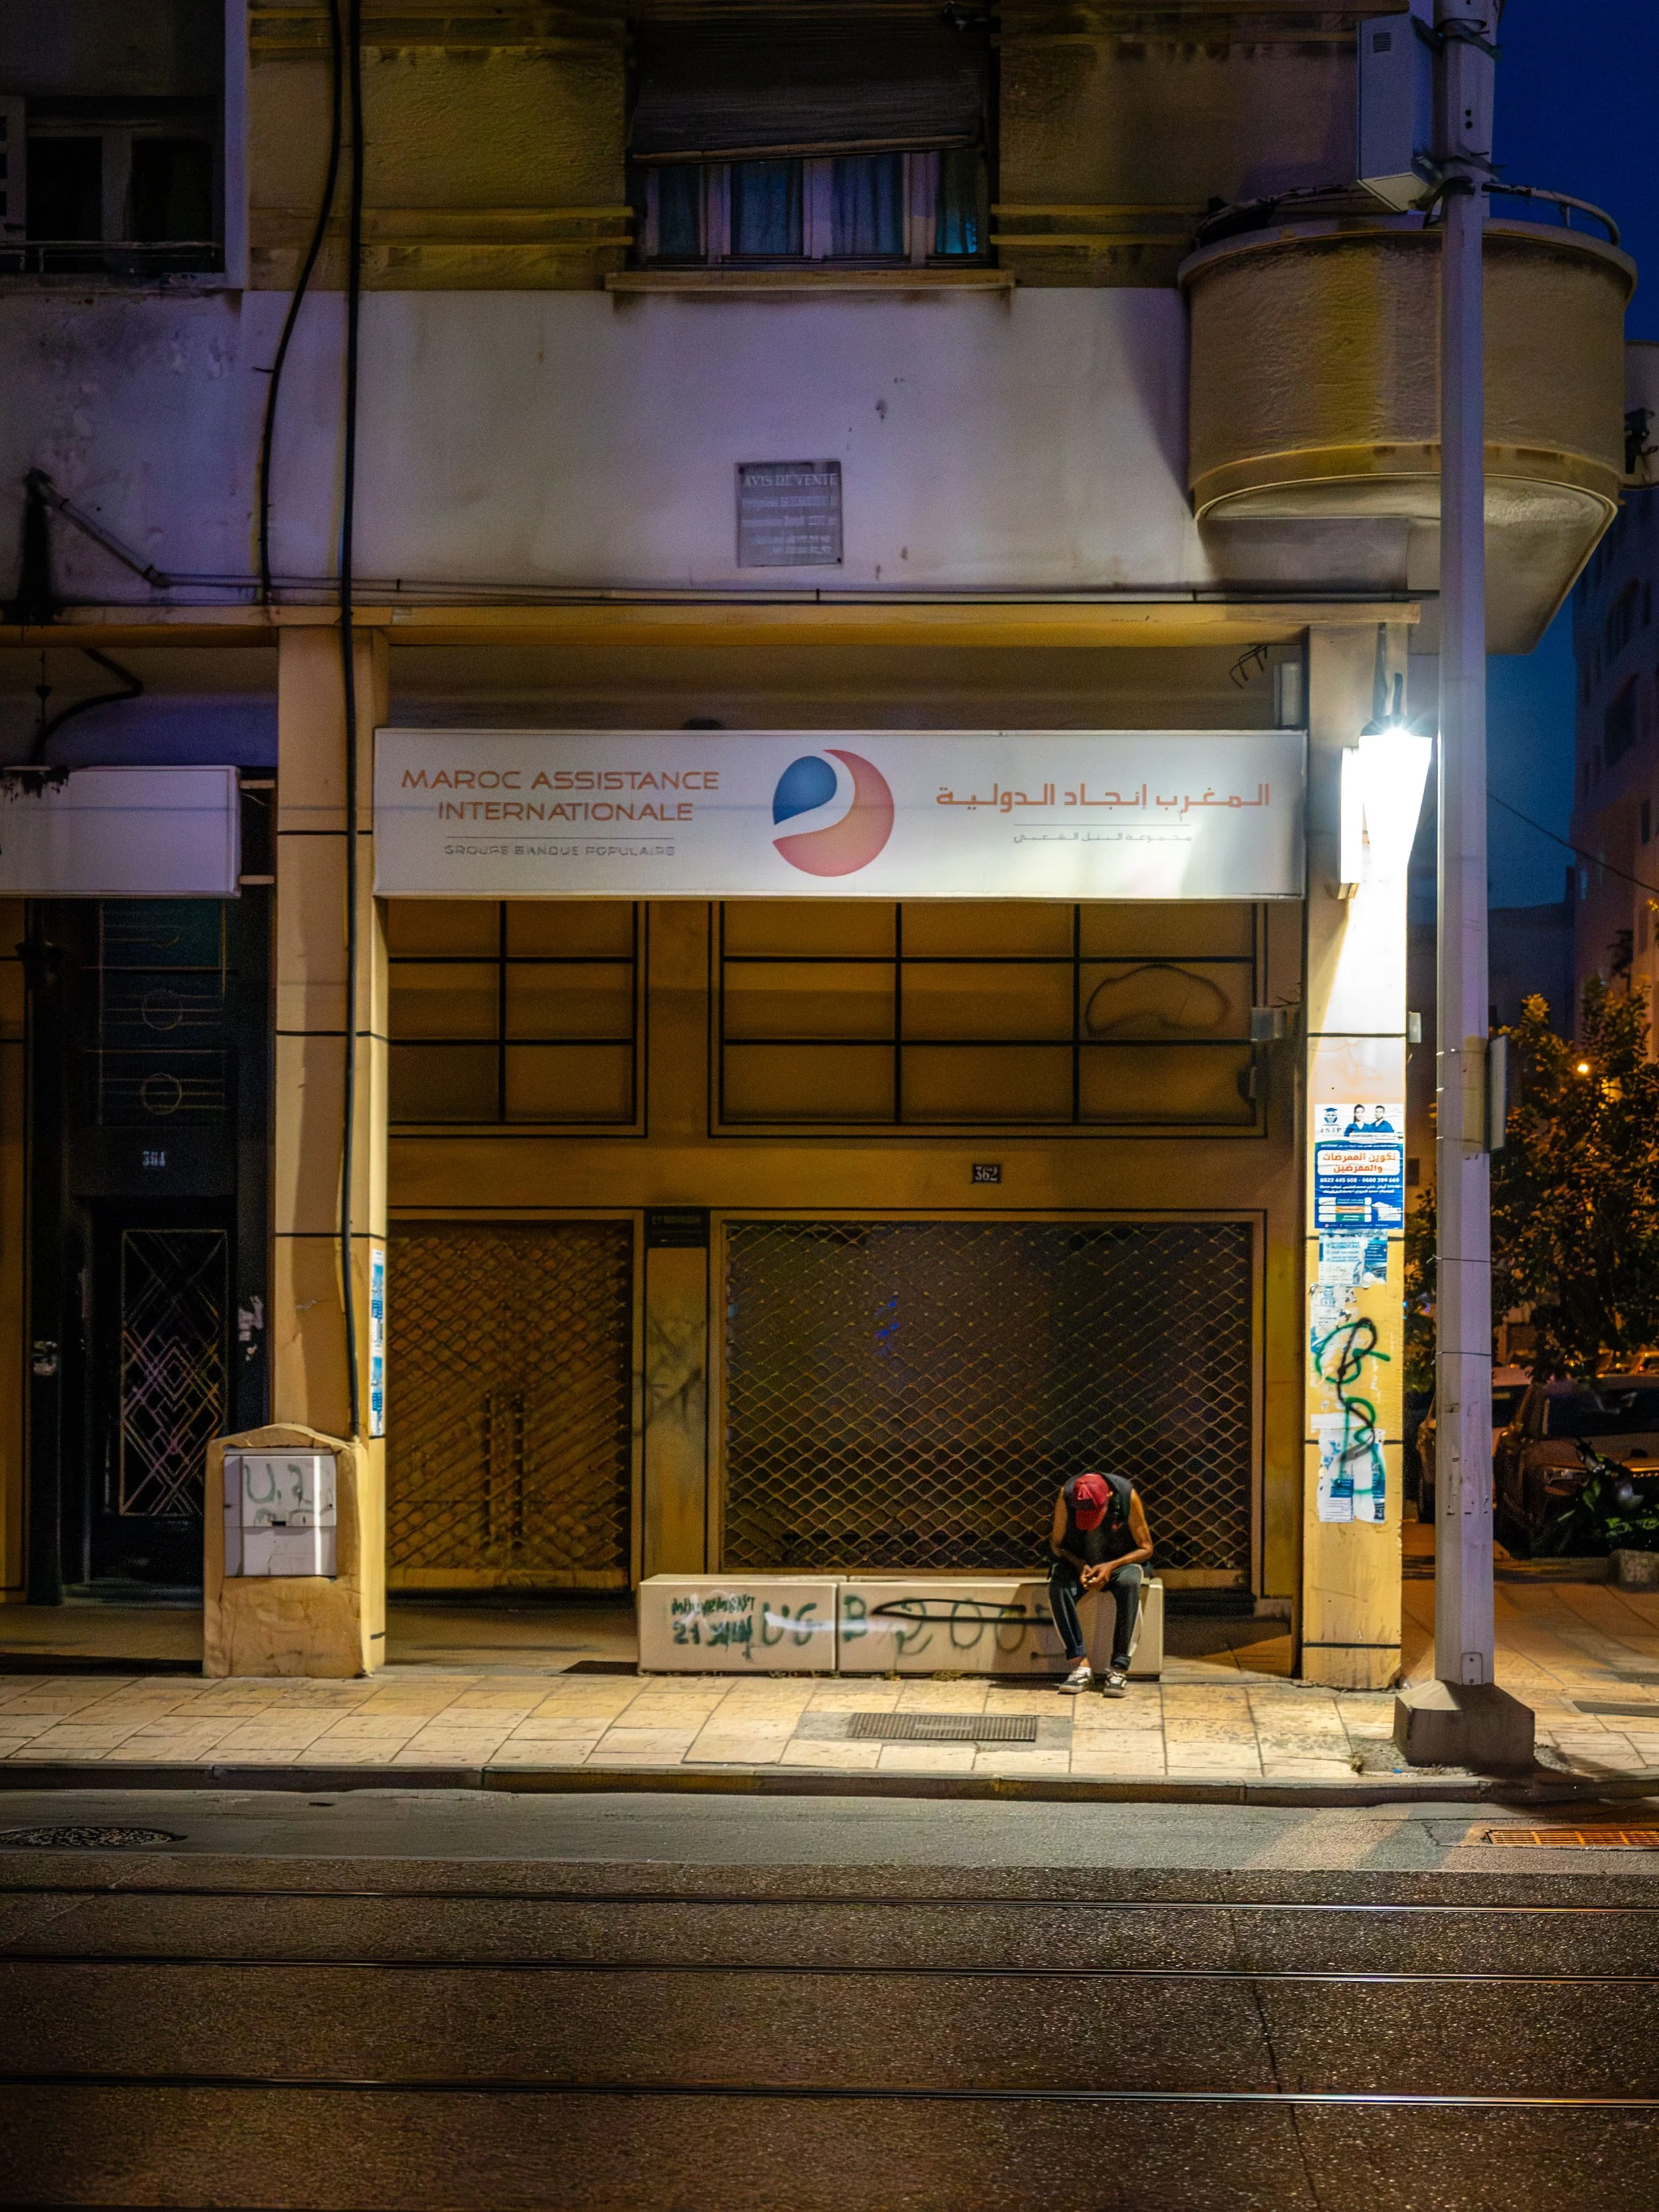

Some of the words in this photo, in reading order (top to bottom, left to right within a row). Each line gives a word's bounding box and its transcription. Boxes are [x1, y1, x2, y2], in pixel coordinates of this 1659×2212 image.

[401, 769, 522, 790] MAROC
[531, 771, 719, 790] ASSISTANCE
[936, 783, 1054, 813] الدولية
[1156, 783, 1269, 813] المغرب
[439, 801, 693, 821] INTERNATIONALE
[445, 845, 508, 855] GROUPE
[515, 846, 579, 856] BANQUE
[585, 846, 675, 856] POPULAIRE
[1323, 1153, 1366, 1162] الممرضات
[1369, 1153, 1396, 1162] تكوين
[975, 1166, 998, 1181] 362
